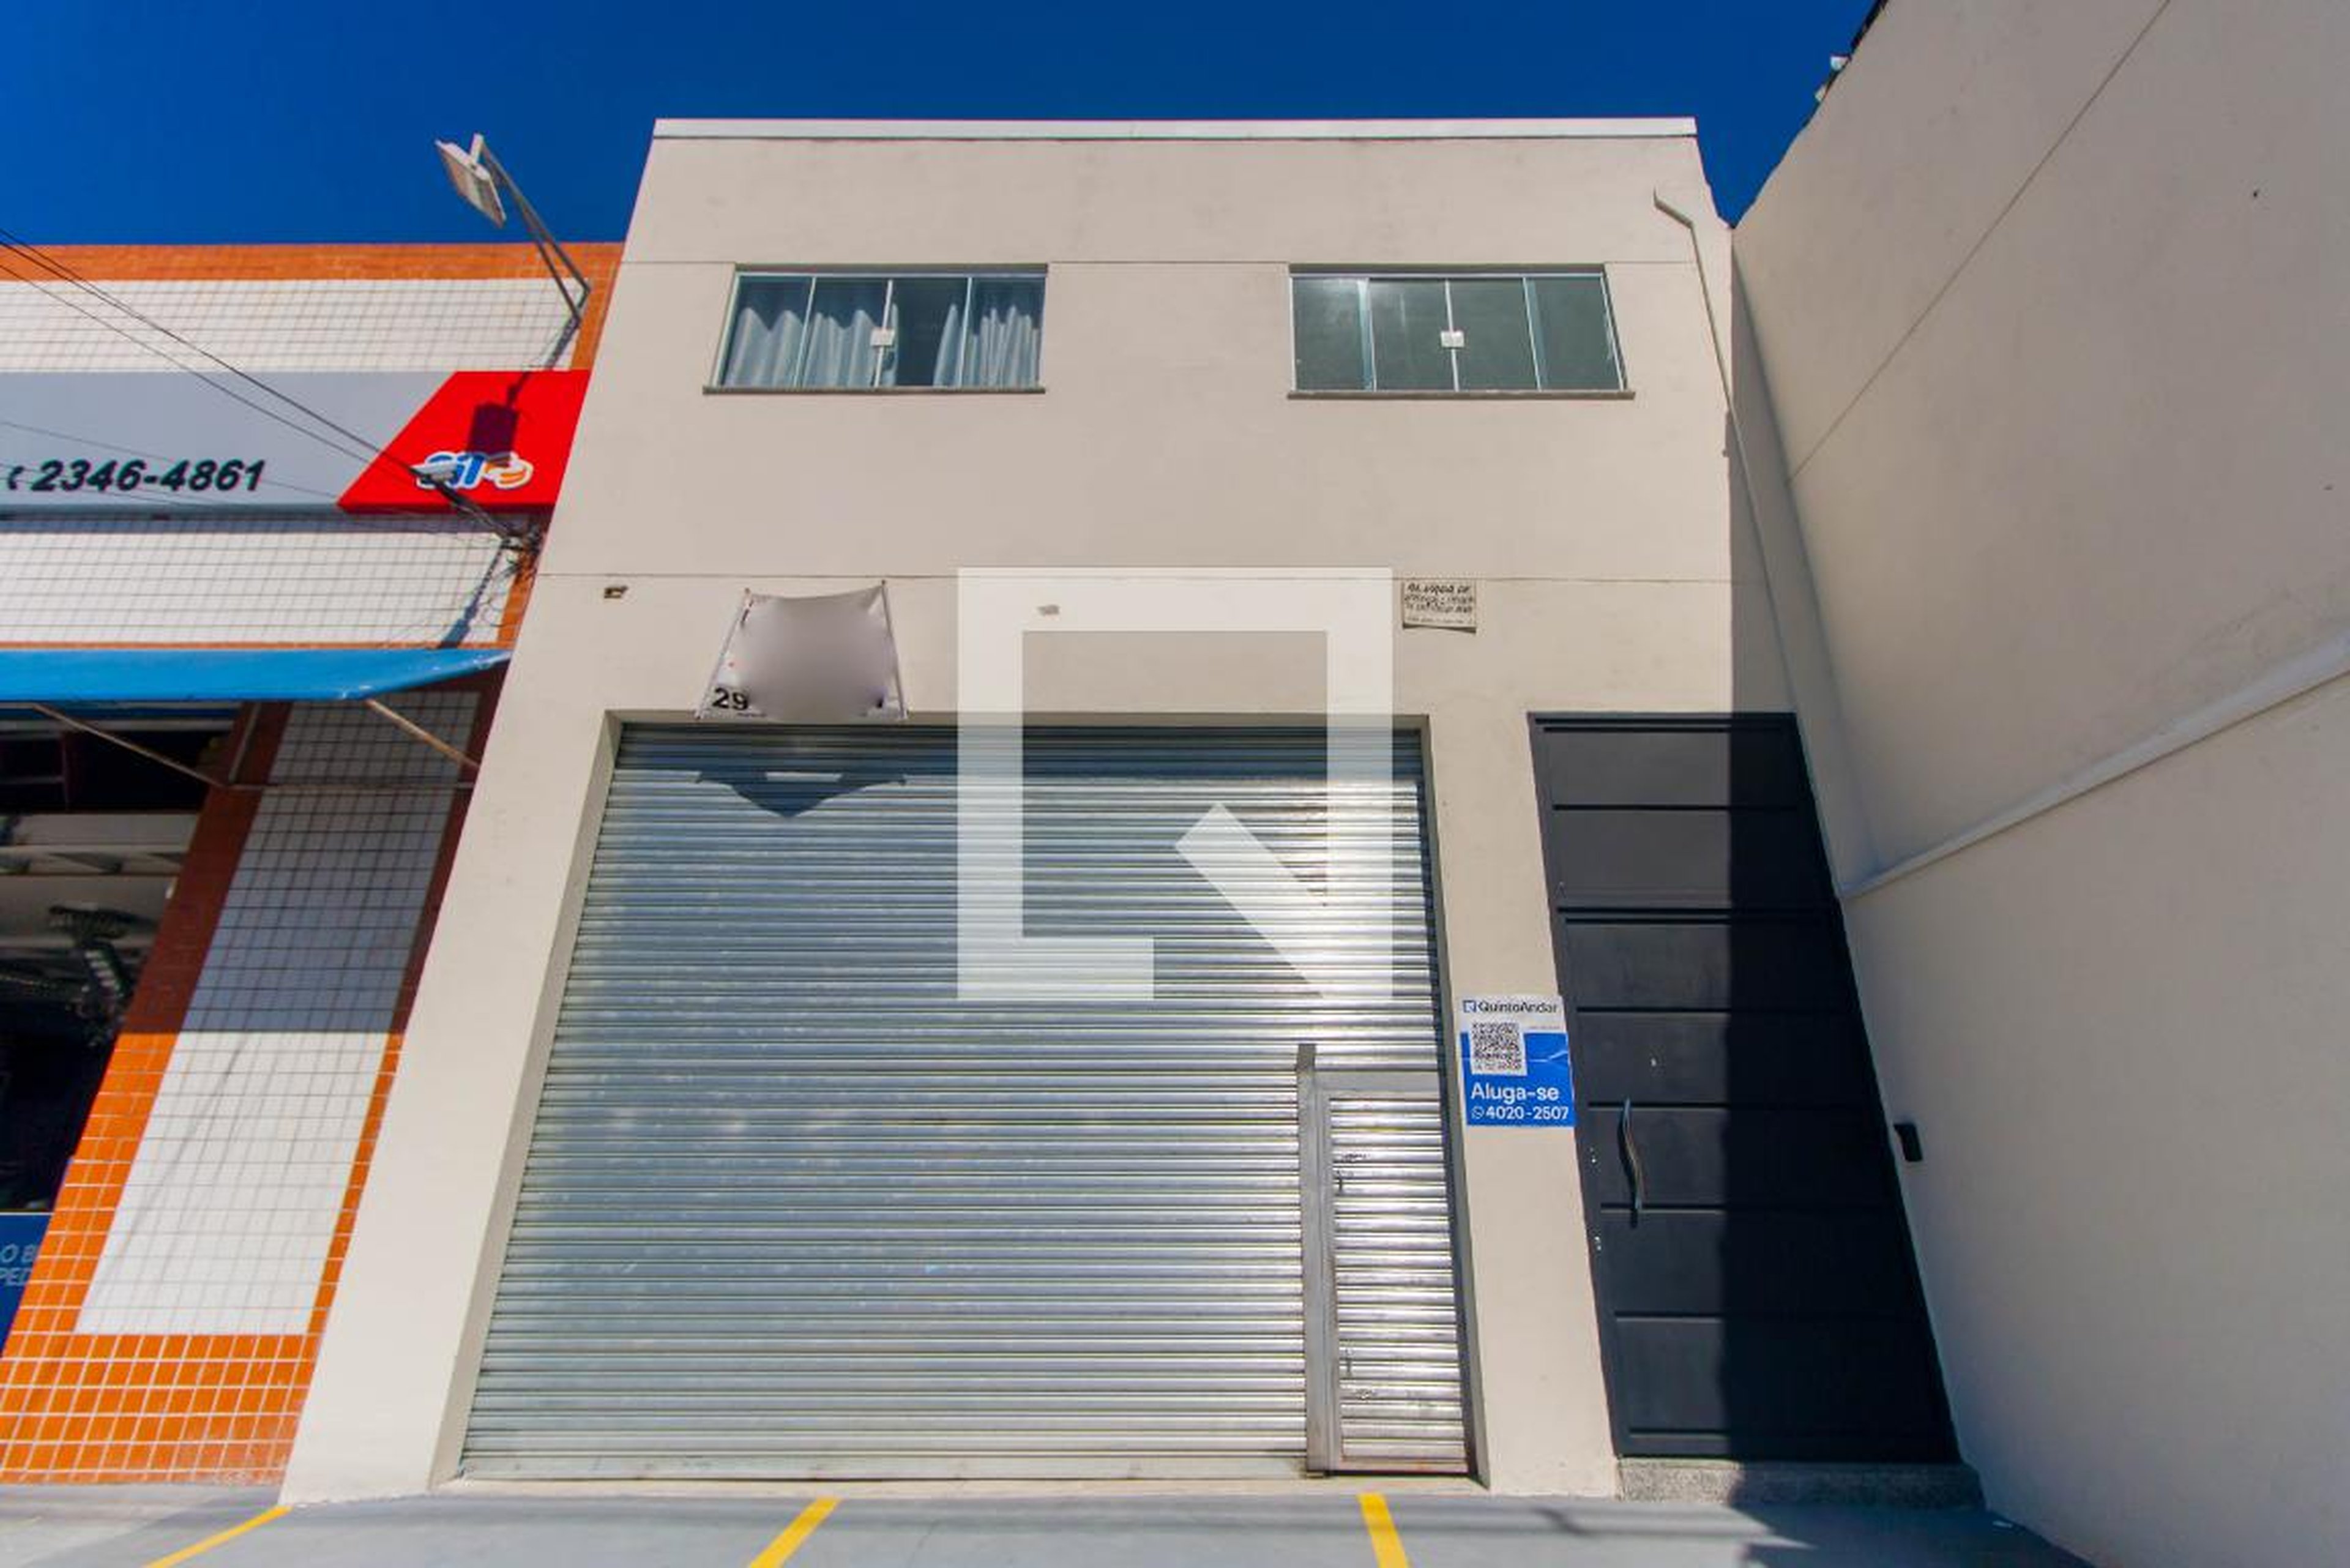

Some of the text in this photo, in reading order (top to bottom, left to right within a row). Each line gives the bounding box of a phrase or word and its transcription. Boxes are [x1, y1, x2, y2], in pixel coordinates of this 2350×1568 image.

[30, 459, 266, 491] 2346-4861
[1478, 1000, 1557, 1014] QuintoAndar
[1471, 1082, 1559, 1105] Aluga-se
[1485, 1106, 1569, 1119] 4020-2507
